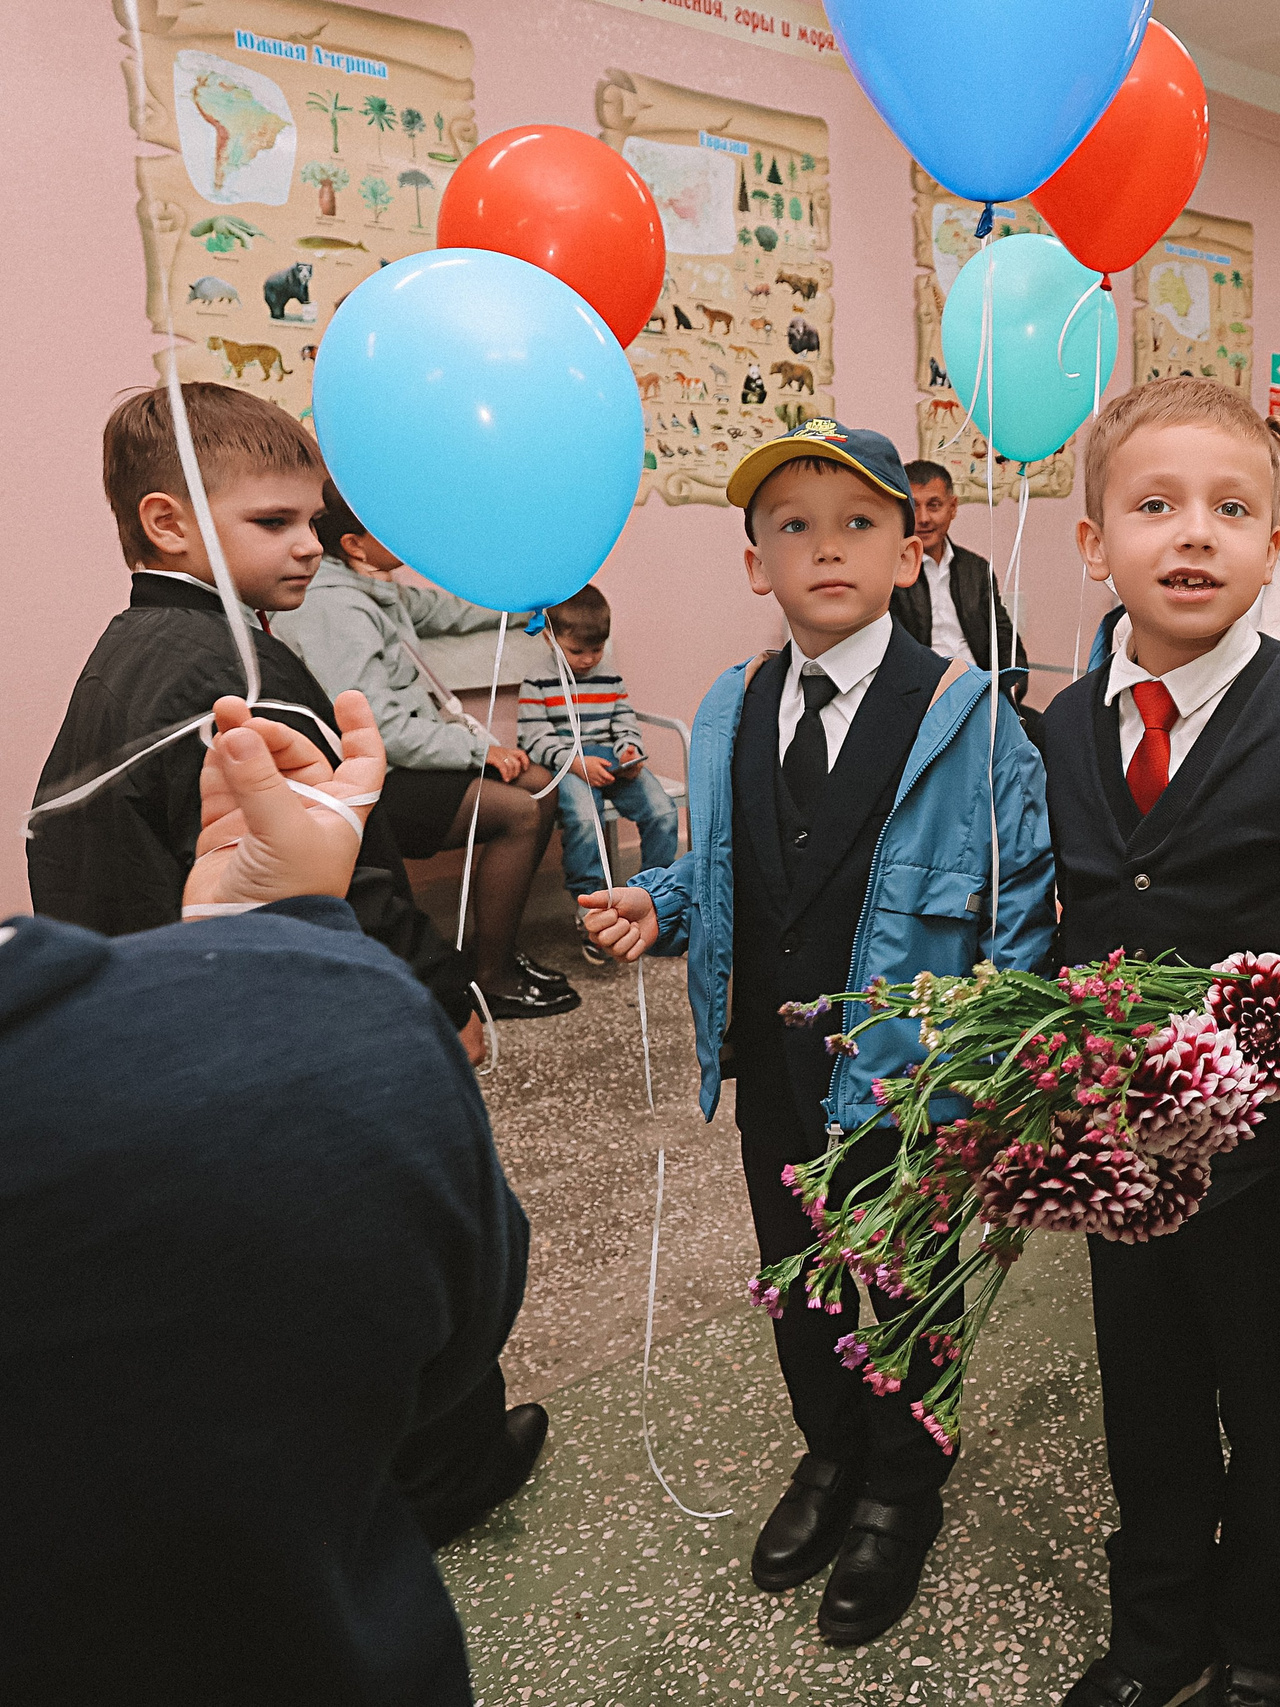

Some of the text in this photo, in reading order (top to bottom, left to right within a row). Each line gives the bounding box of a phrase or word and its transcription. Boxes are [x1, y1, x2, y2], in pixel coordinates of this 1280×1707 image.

[735, 6, 775, 34] горы
[781, 20, 791, 38] и
[235, 29, 387, 78] Южная Америка
